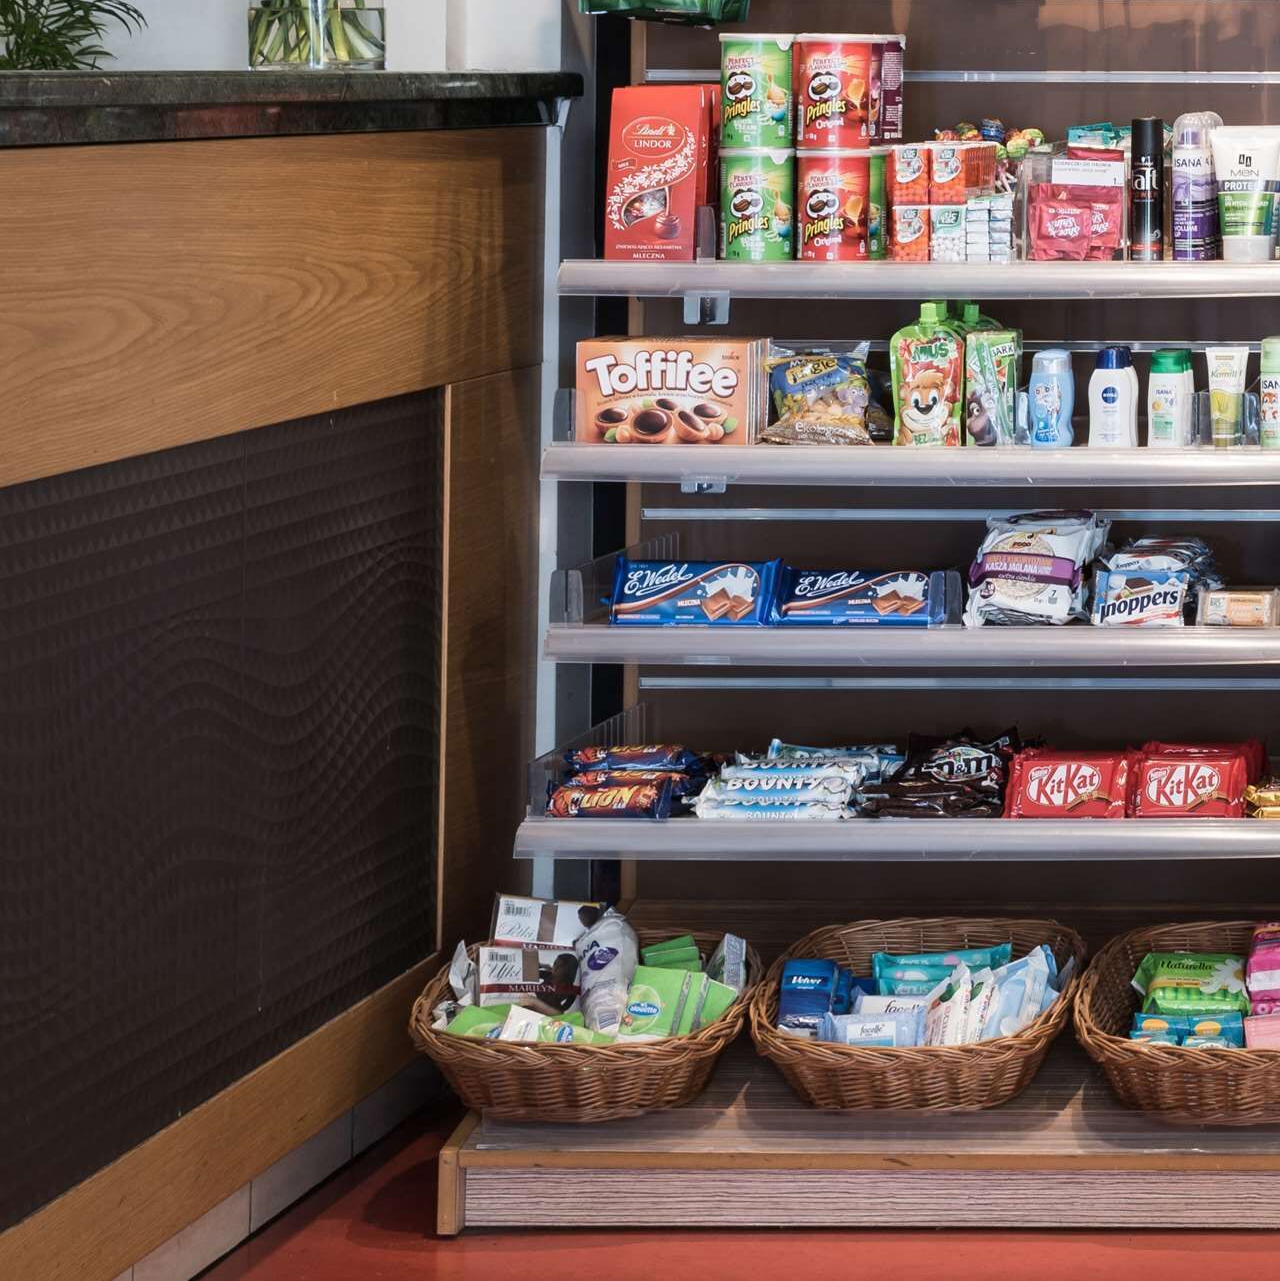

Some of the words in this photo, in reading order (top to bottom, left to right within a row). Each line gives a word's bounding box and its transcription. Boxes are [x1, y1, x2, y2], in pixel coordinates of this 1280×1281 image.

[723, 96, 761, 125] Pringles
[805, 95, 847, 126] Pringles
[634, 139, 672, 148] LINDOR
[1174, 158, 1202, 168] ISANA
[1224, 181, 1259, 191] PROTE
[728, 213, 769, 244] Pringles
[804, 214, 845, 245] Pringles
[585, 349, 739, 398] Toffifee
[624, 563, 694, 596] E.Wedel
[795, 570, 865, 597] E.Wedel
[579, 785, 640, 808] LION
[726, 776, 825, 791] BOUNTY
[1035, 764, 1099, 807] KitKat
[1155, 765, 1217, 807] KitKat
[507, 983, 557, 992] MARILYN
